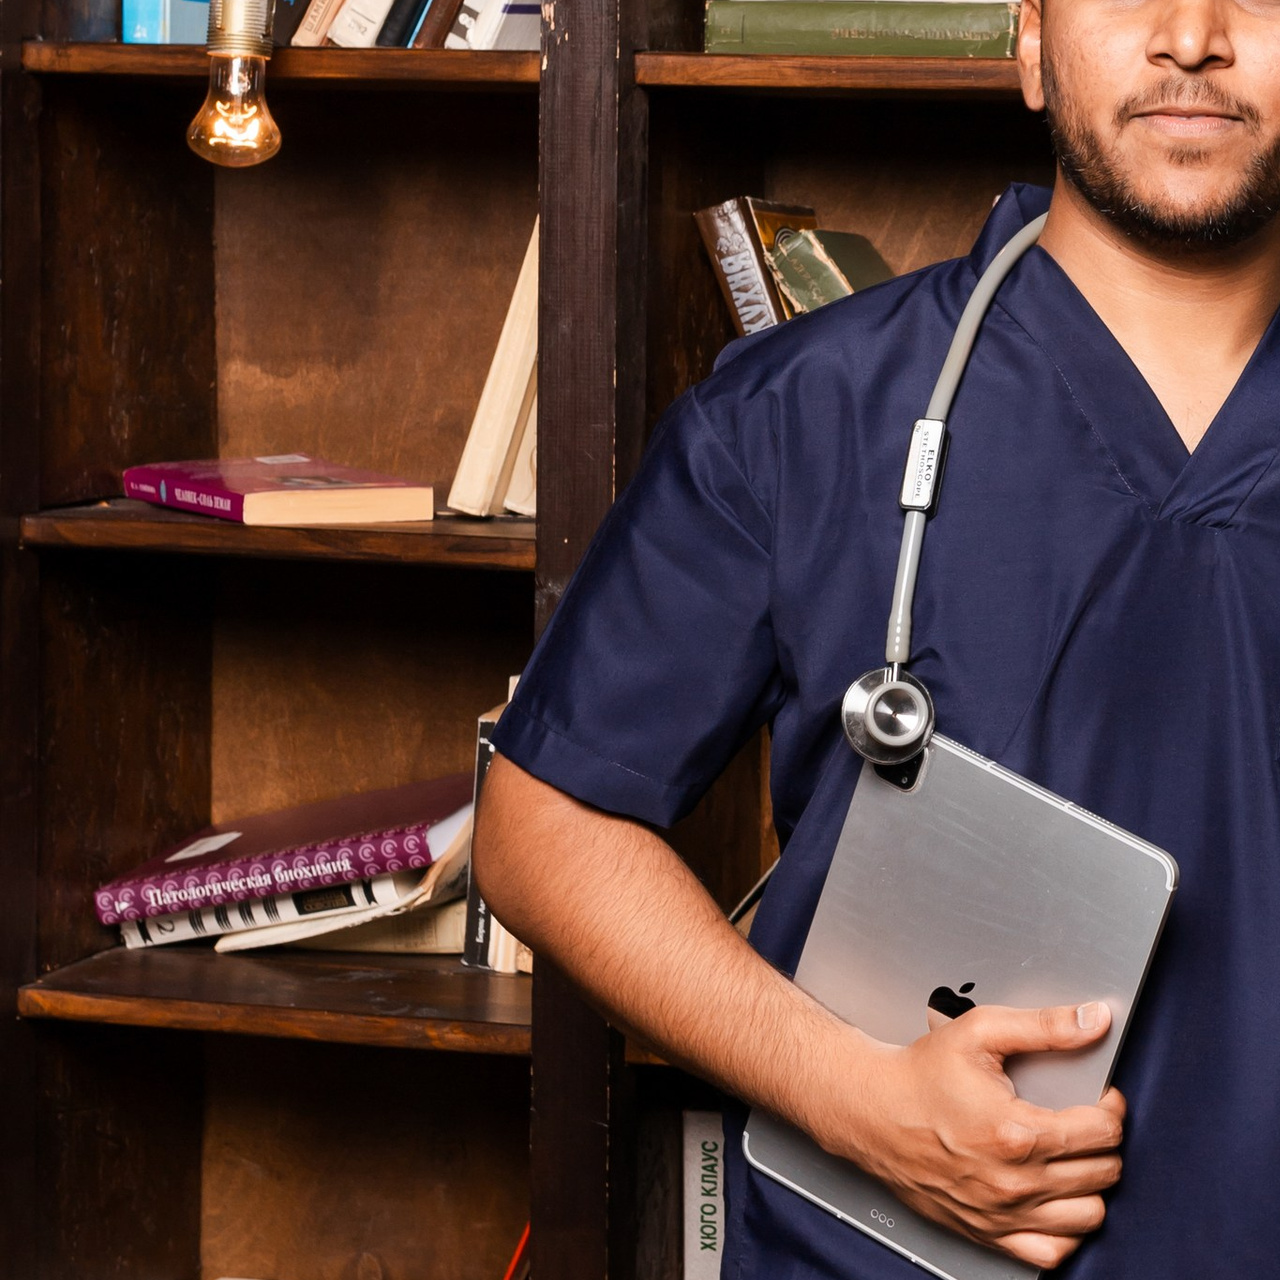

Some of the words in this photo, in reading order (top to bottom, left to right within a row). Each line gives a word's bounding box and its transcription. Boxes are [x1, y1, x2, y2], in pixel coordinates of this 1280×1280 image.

[717, 246, 776, 336] КУХНЯ
[912, 430, 933, 500] STETHOSCOPE
[922, 448, 937, 483] ELKO
[146, 866, 274, 909] Патологическая
[271, 851, 354, 886] биохимия
[474, 915, 486, 944] Борис
[698, 1139, 719, 1198] КЛАУС
[699, 1201, 717, 1252] ХЮГО
